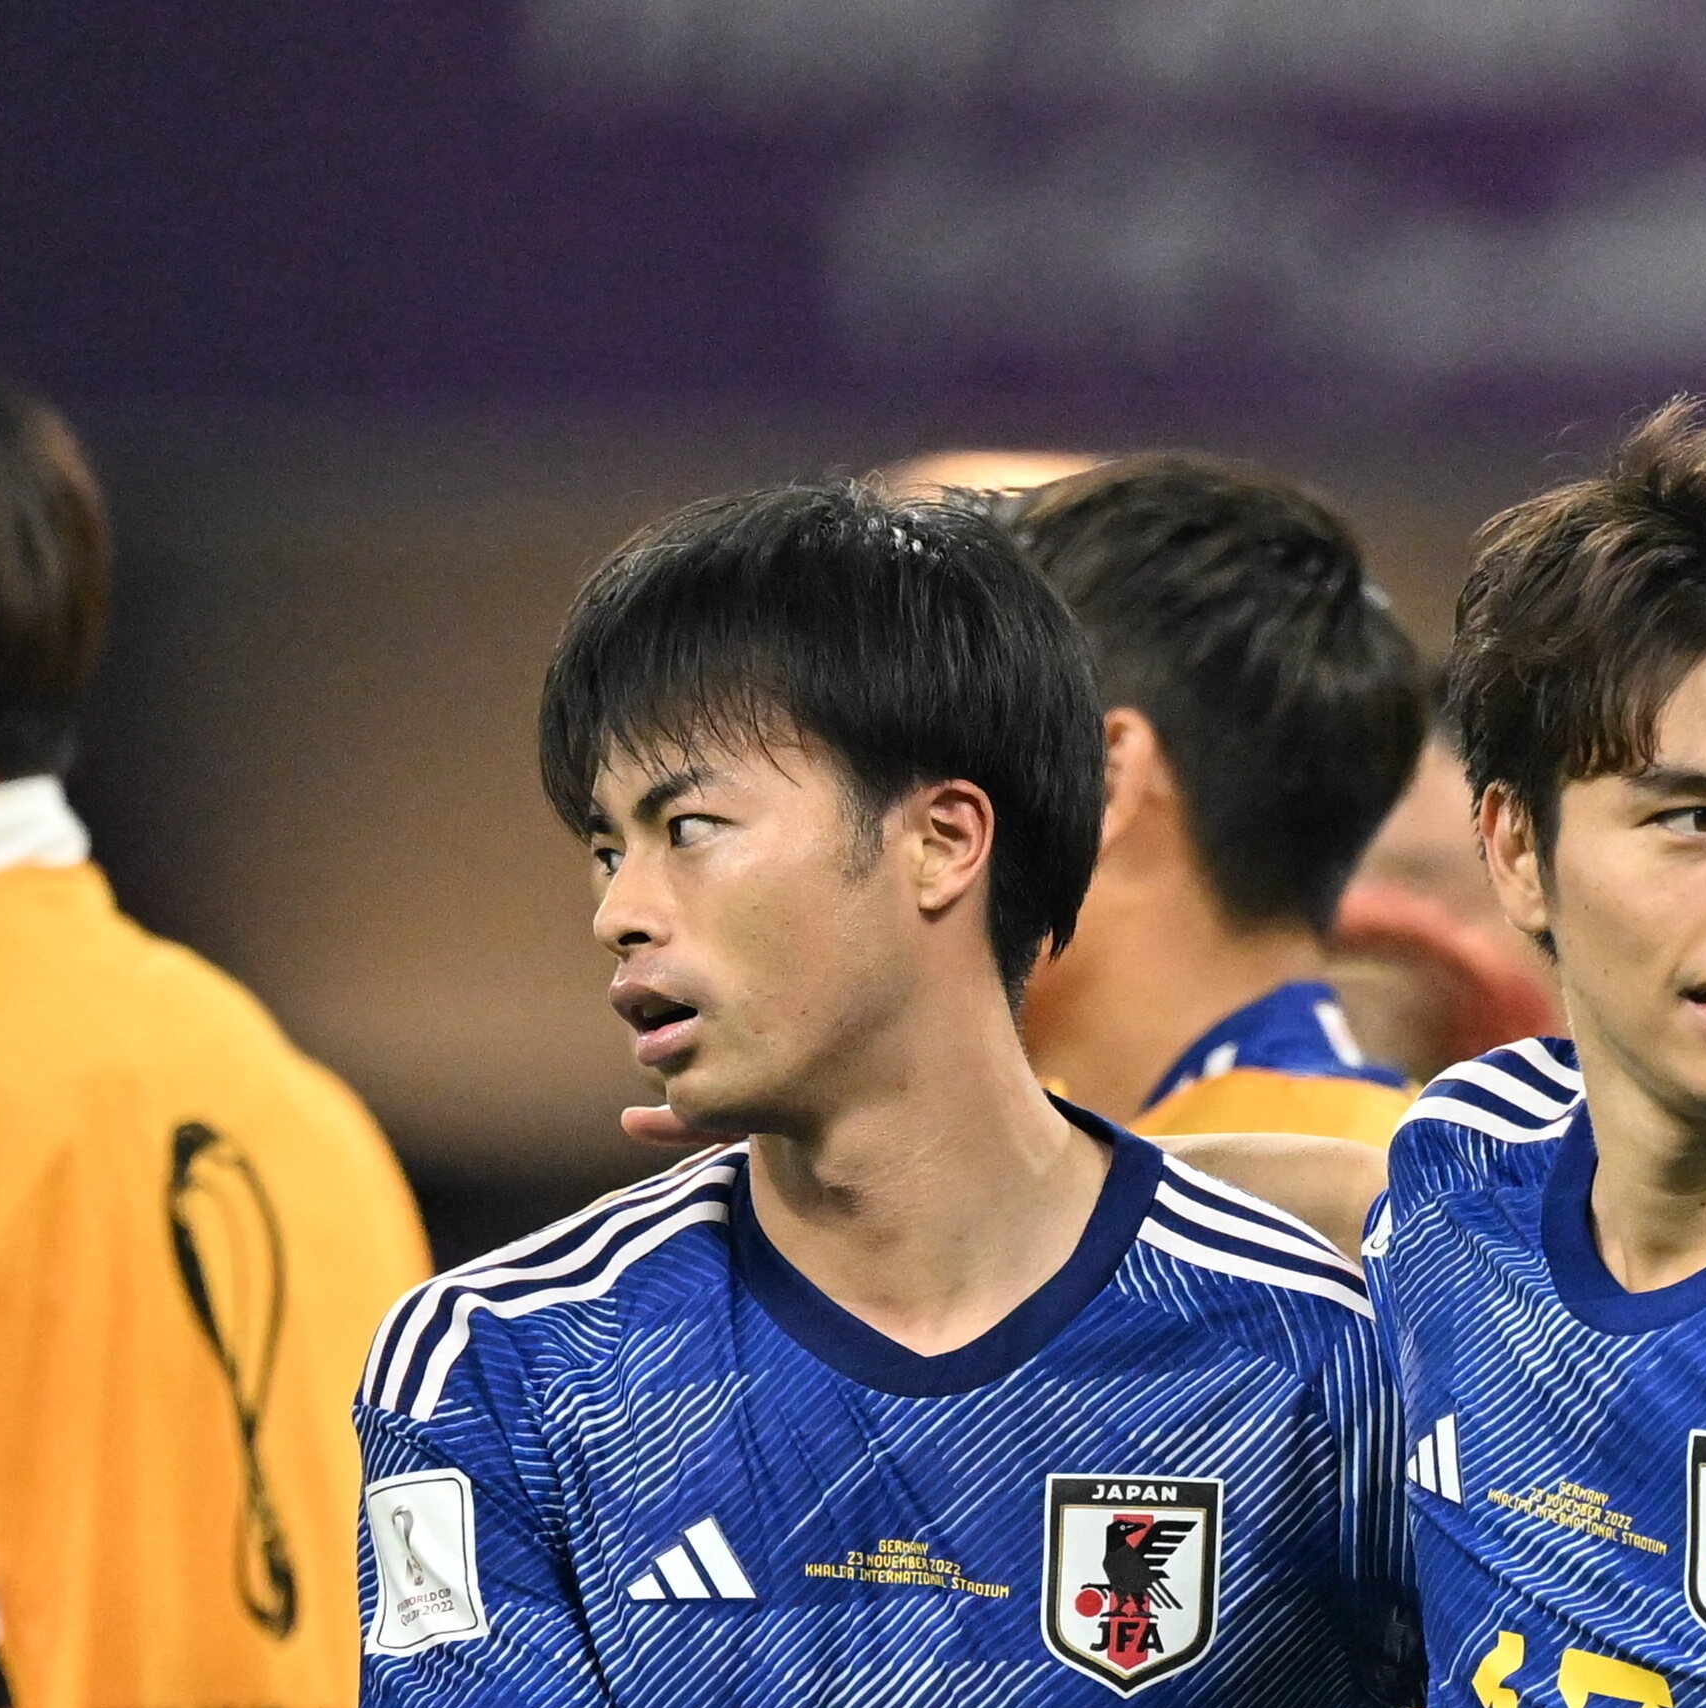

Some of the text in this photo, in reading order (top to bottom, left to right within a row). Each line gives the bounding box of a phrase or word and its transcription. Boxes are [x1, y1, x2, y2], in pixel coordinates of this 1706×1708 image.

[1091, 1484, 1178, 1502] JAPAN
[1558, 1481, 1609, 1507] GERMANY
[1604, 1510, 1633, 1530] 2022
[878, 1539, 929, 1556] GERMANY
[1621, 1532, 1668, 1557] STADIUM
[847, 1551, 961, 1576] 23 NOVEMBER 2022
[951, 1577, 1010, 1599] STADIUM
[422, 1600, 455, 1616] 2022
[1090, 1621, 1165, 1653] JFA
